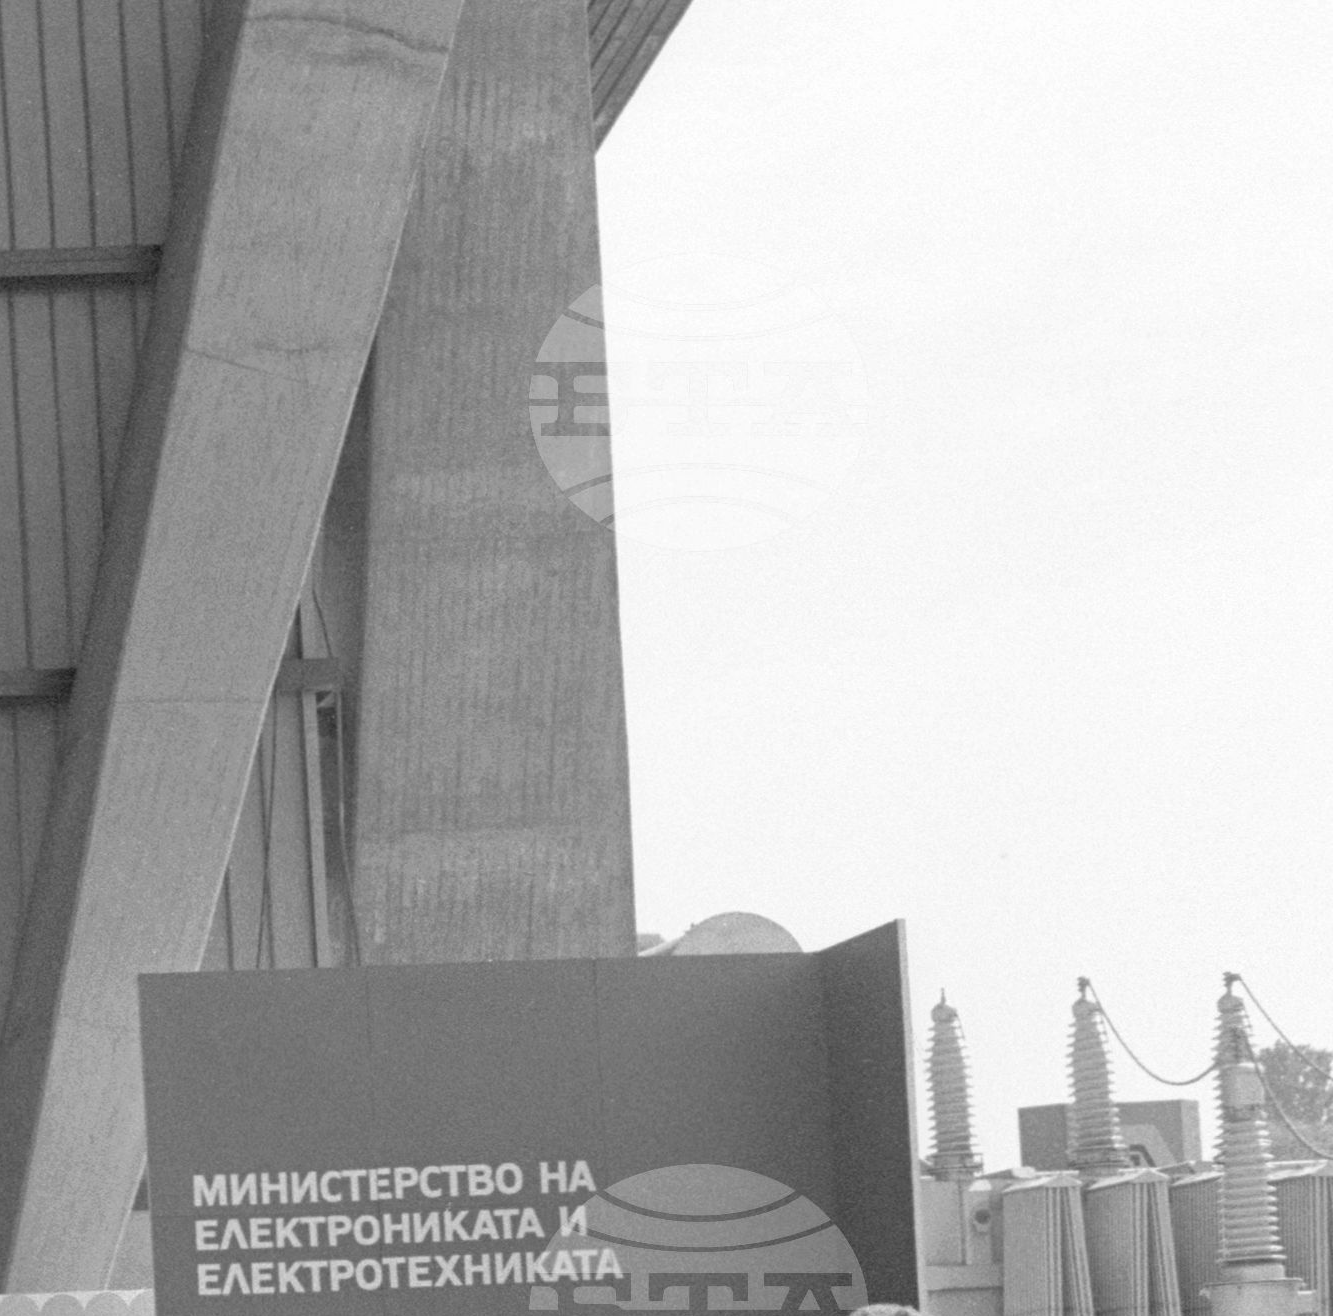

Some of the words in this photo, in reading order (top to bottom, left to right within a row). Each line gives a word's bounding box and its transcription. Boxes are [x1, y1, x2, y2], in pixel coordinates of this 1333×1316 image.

[192, 1164, 524, 1207] МИНИСТЕРСТВО
[539, 1160, 597, 1194] НА
[194, 1207, 546, 1251] ЕЛЕКТРОНИКАТА
[559, 1205, 588, 1238] И
[196, 1248, 624, 1296] ЕЛЕКТРОТЕХНИКАТА
